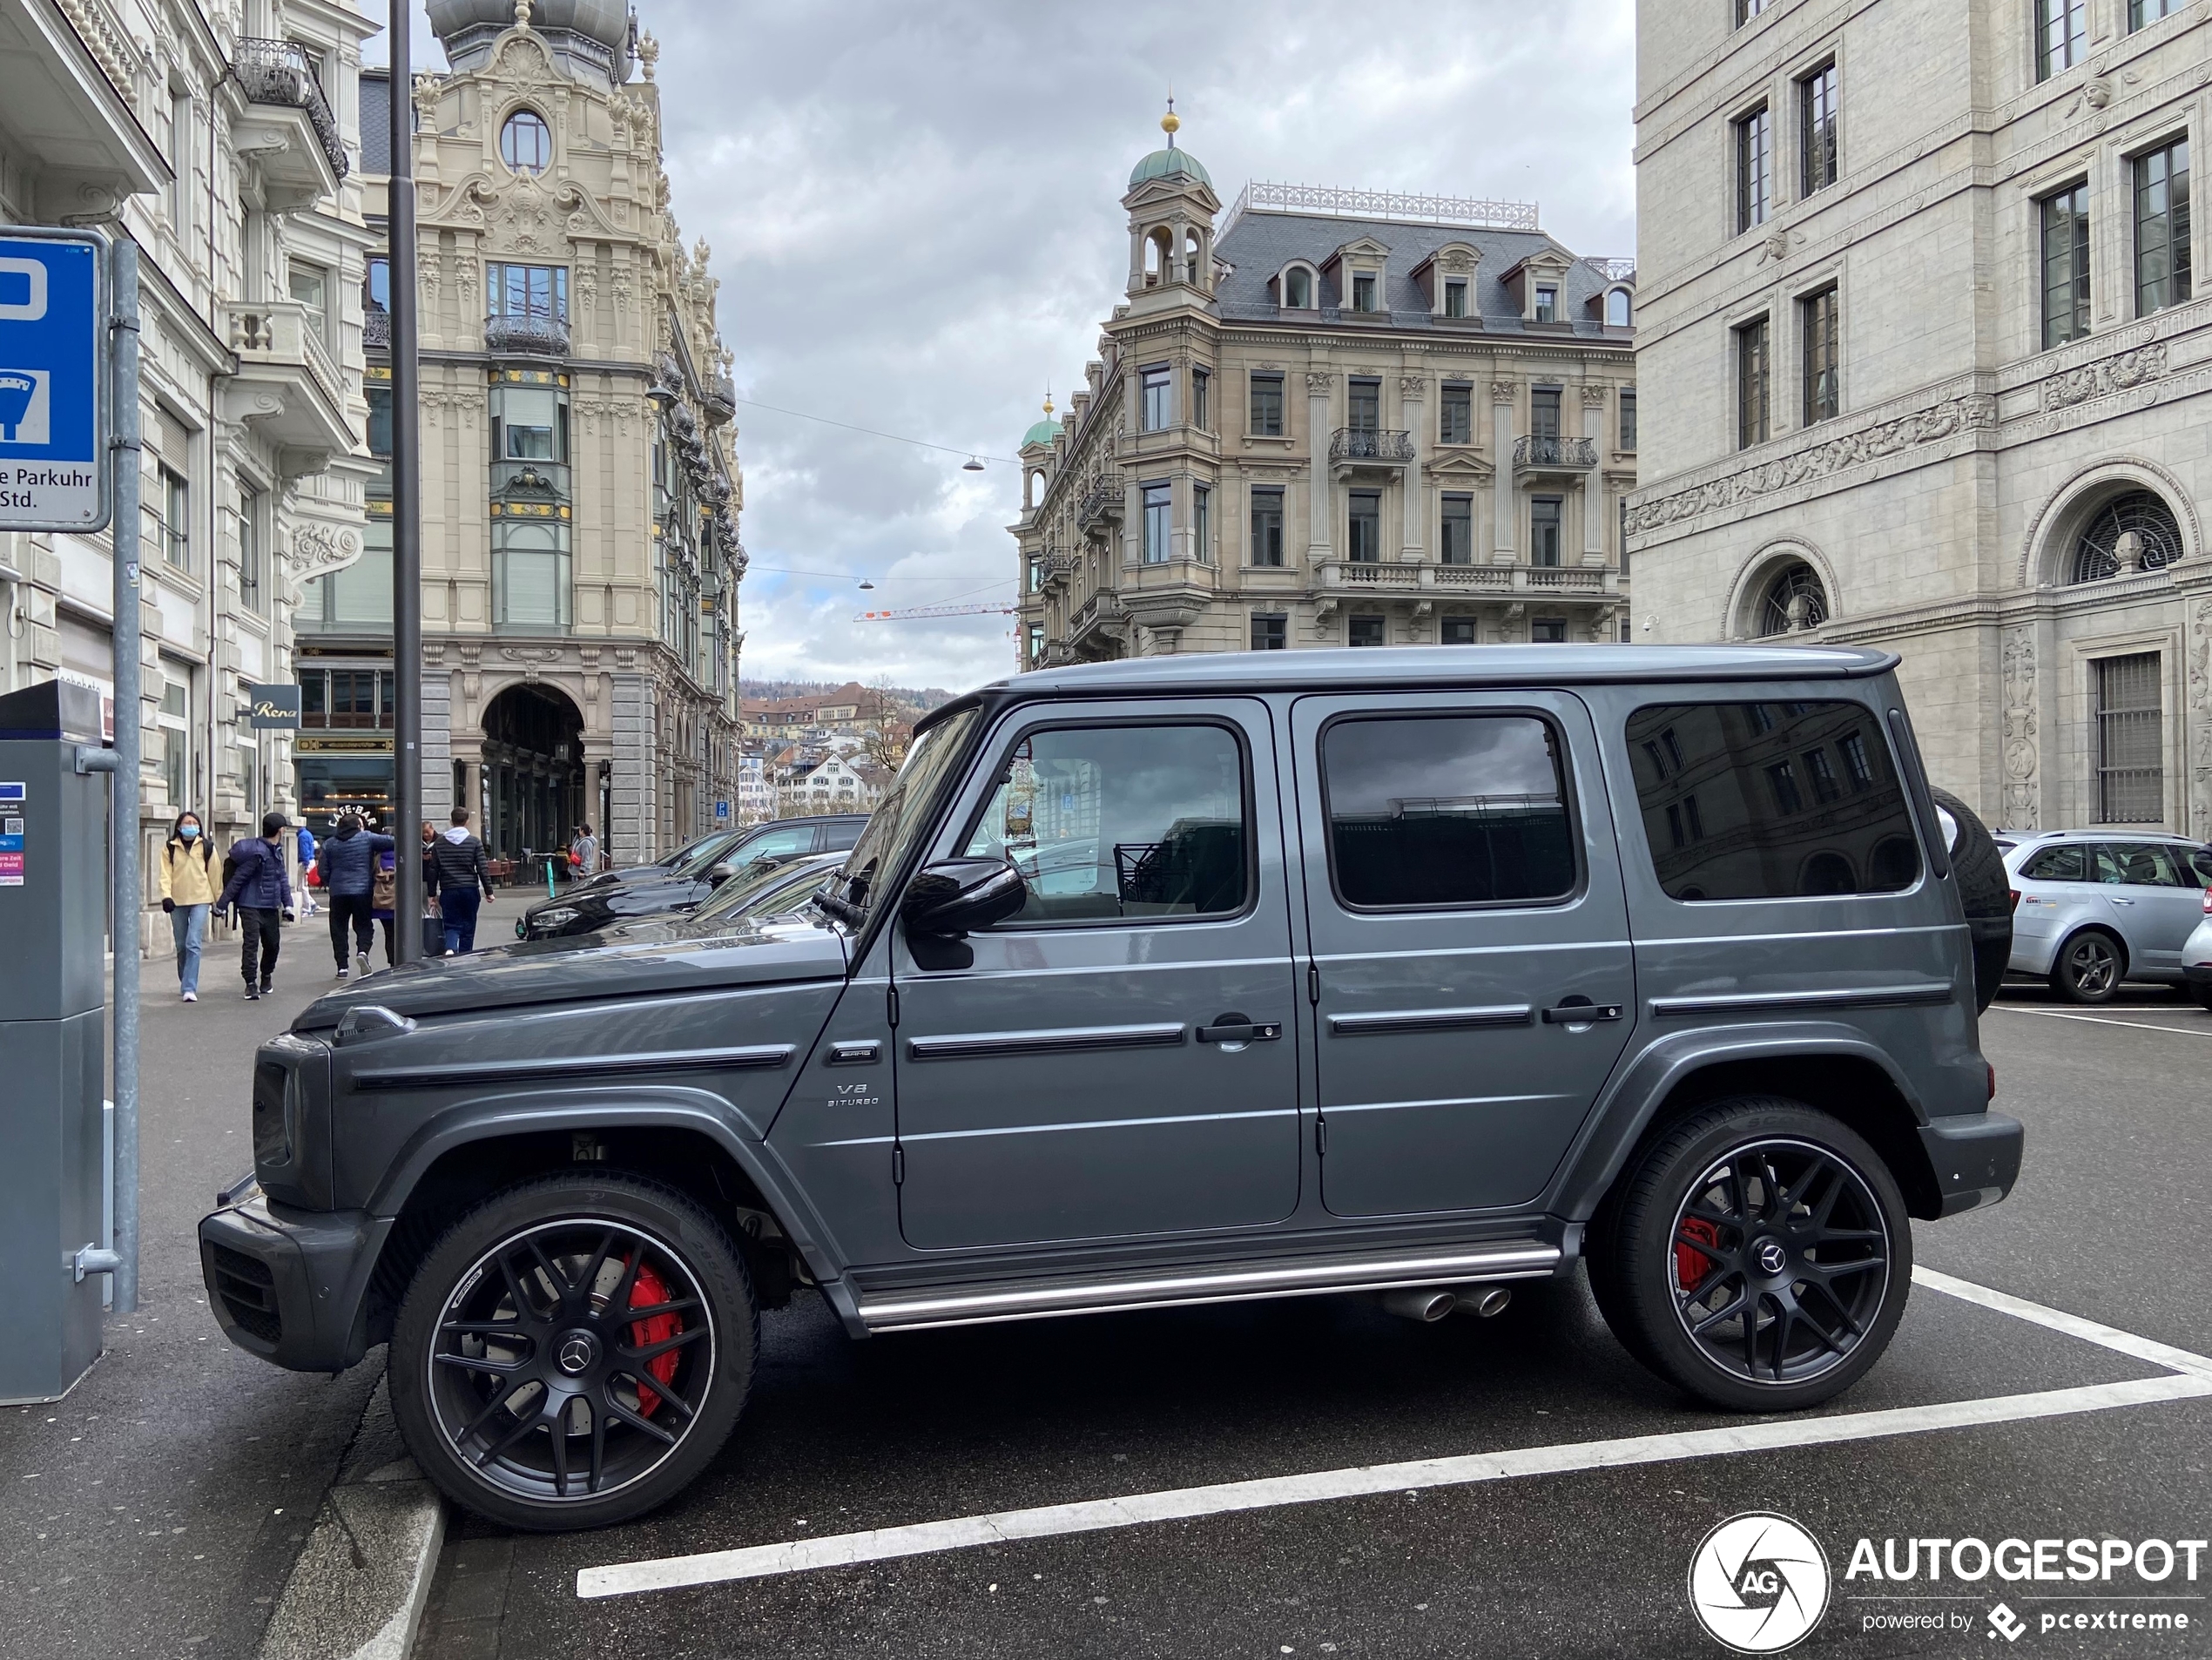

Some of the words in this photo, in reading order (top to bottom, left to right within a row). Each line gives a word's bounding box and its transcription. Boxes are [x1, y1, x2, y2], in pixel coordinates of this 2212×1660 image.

[17, 469, 92, 487] Parkuhr
[0, 490, 37, 508] Std.
[253, 700, 297, 718] Rena
[837, 1084, 867, 1094] V8
[827, 1097, 879, 1107] BITURBO
